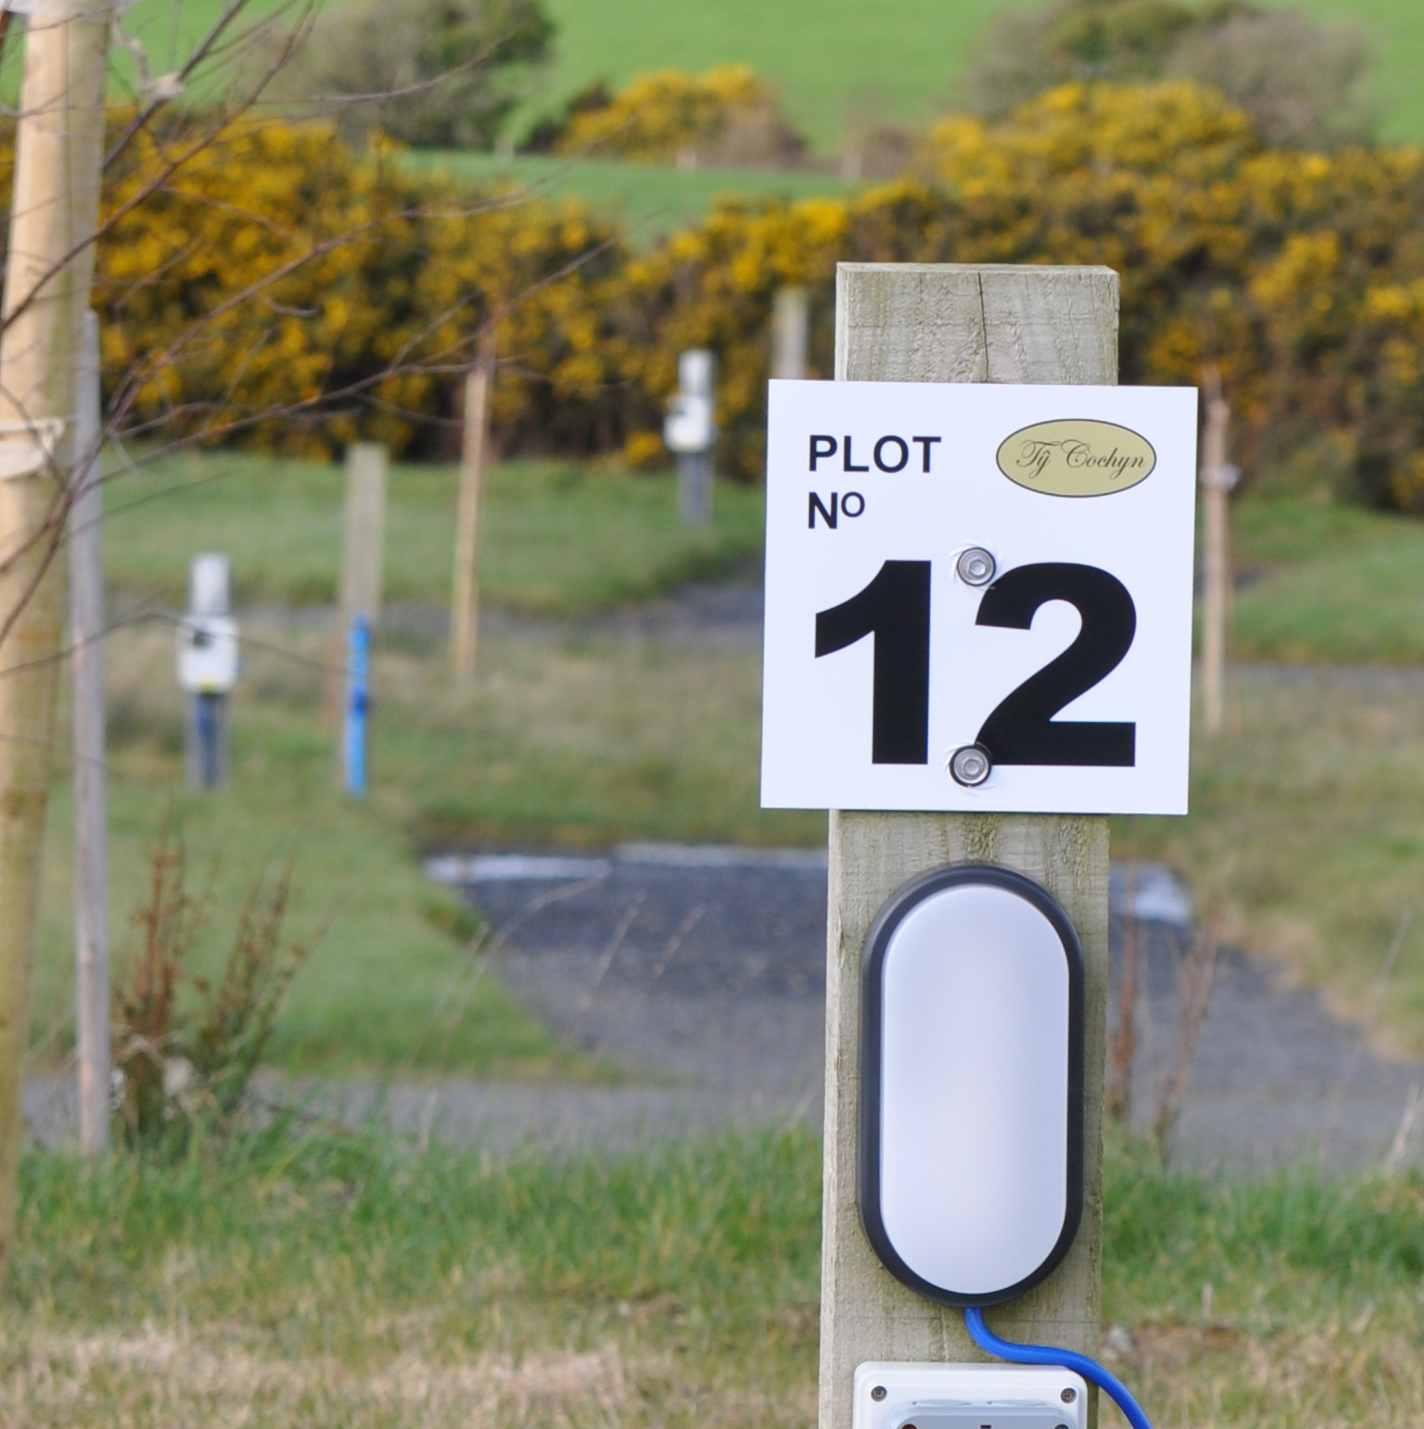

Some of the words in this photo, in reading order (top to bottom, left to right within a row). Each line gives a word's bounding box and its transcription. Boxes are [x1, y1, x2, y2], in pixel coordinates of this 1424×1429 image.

[808, 435, 942, 473] PLOT
[1061, 439, 1144, 479] Cochyn
[815, 560, 1137, 767] 12
